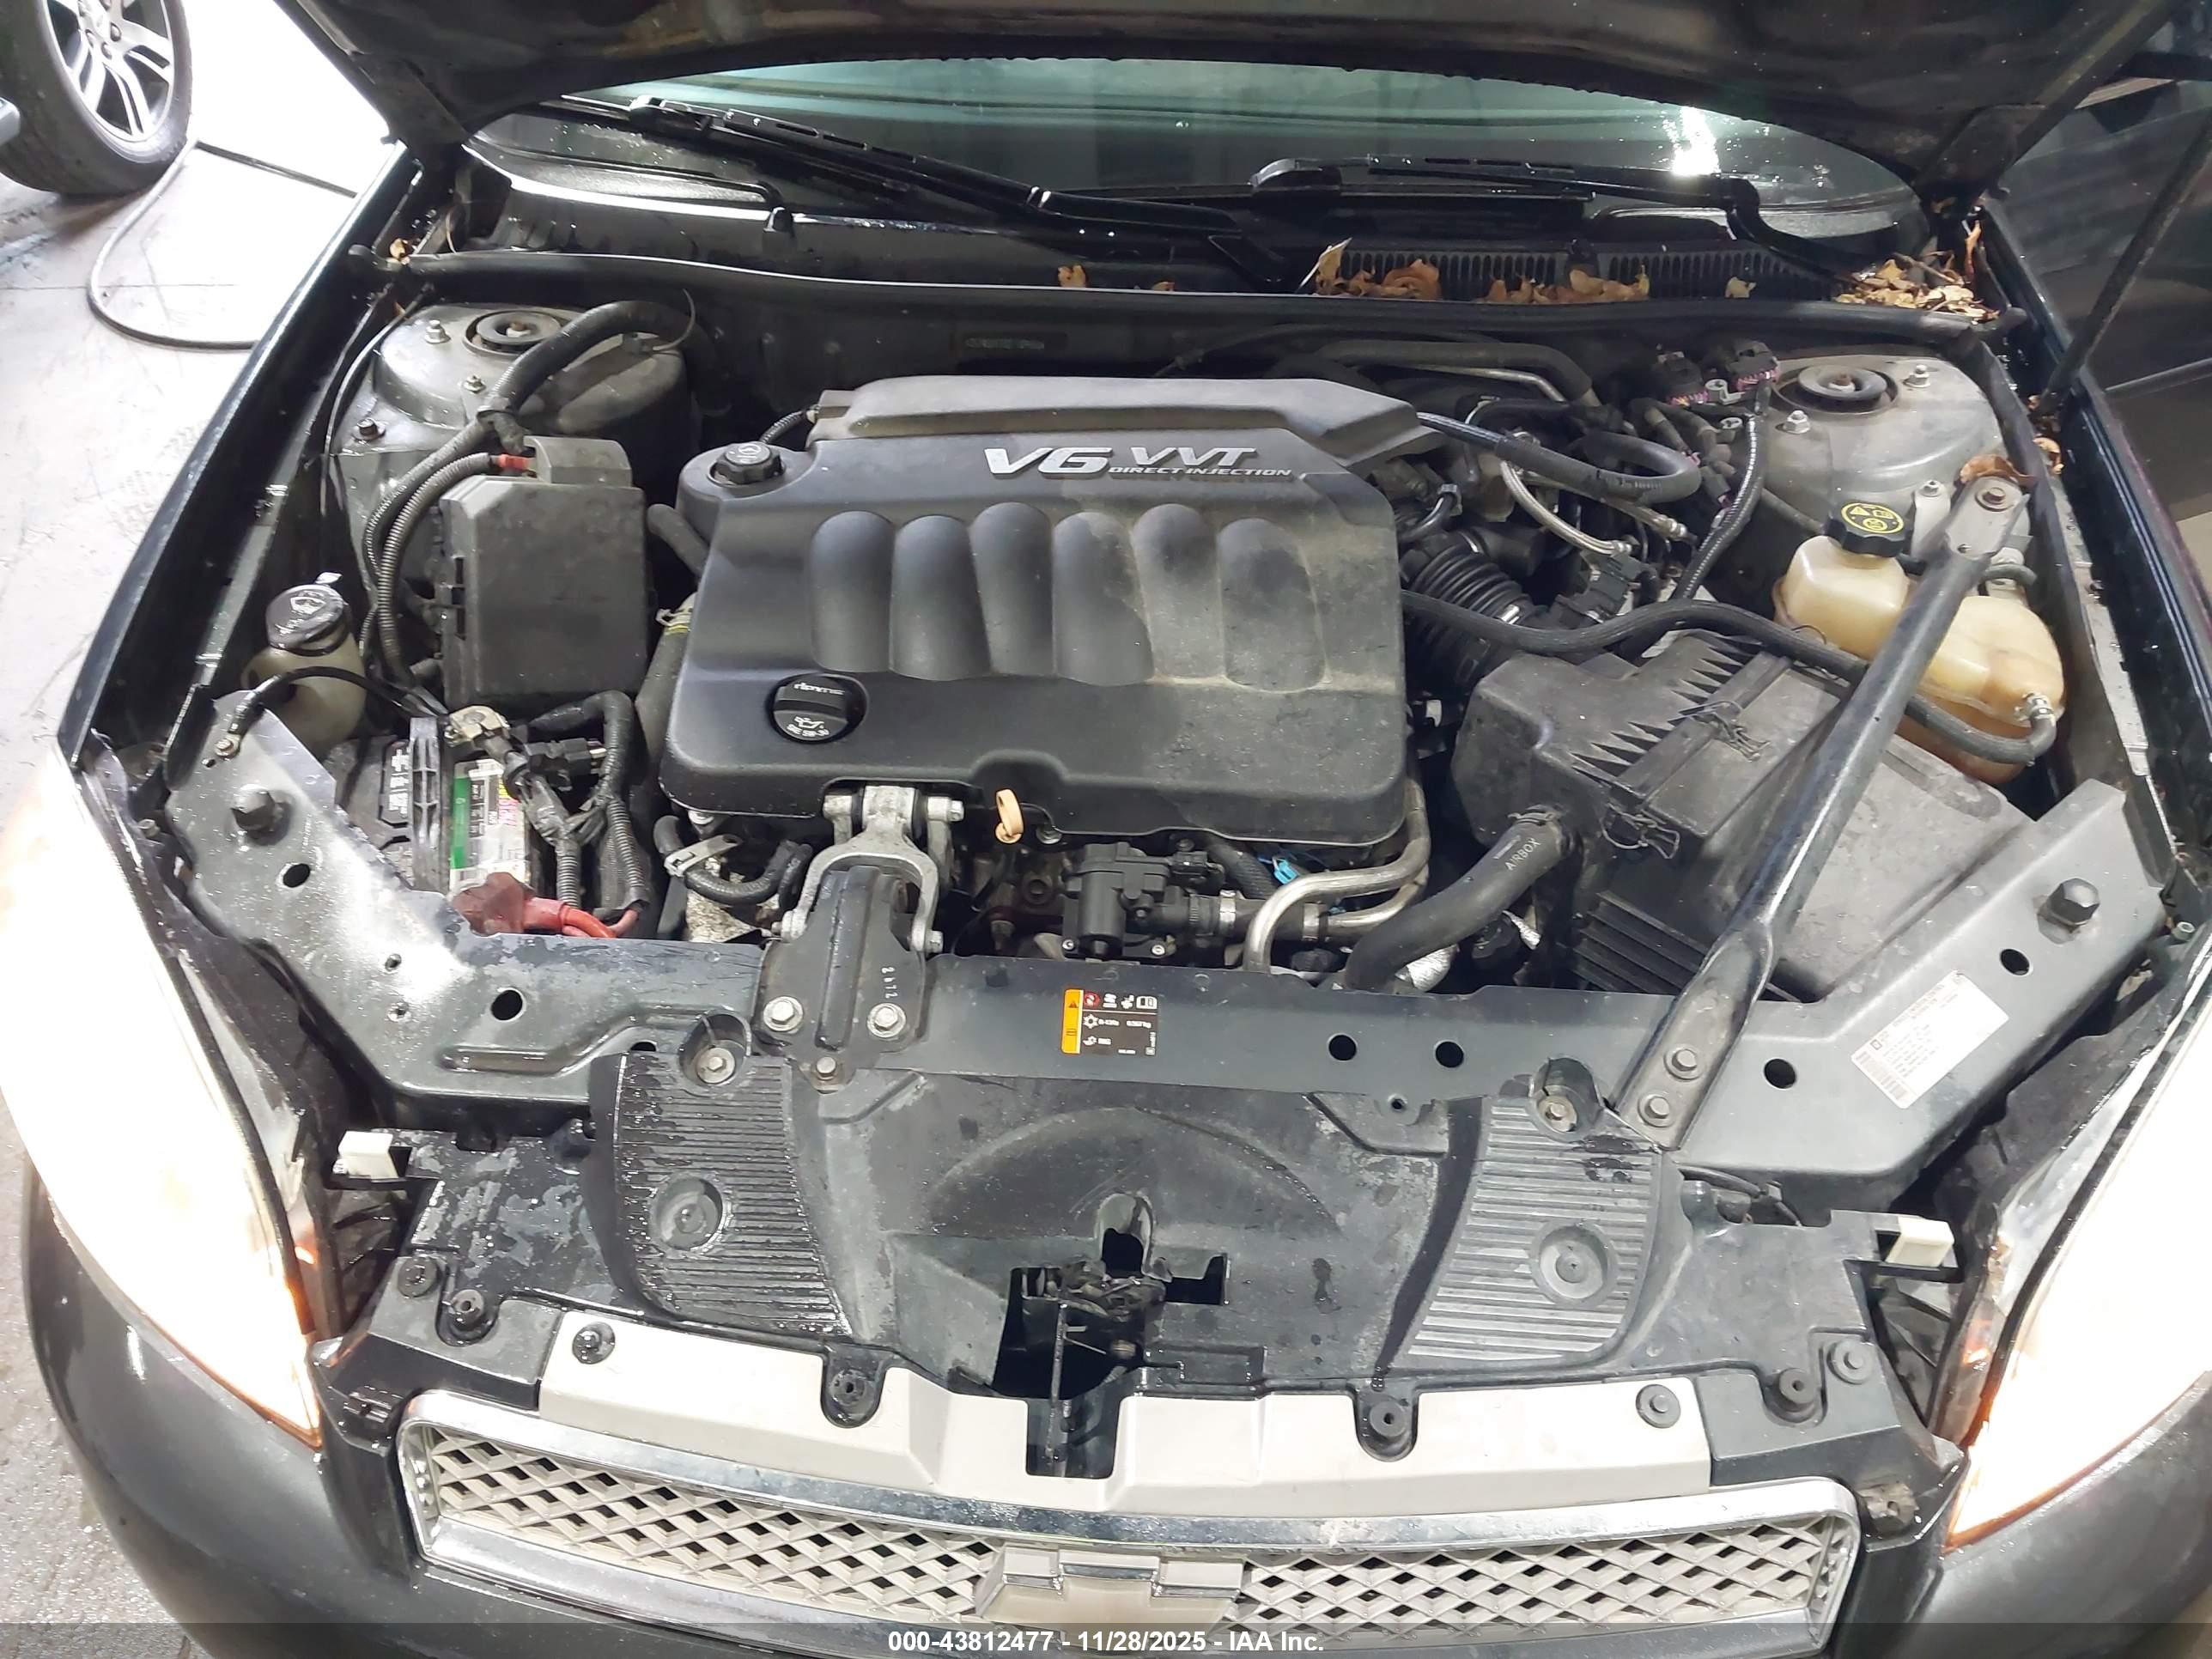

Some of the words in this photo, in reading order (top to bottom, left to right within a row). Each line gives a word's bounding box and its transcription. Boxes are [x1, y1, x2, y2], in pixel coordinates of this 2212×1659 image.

[984, 447, 1113, 474] V6
[1130, 447, 1257, 466] VVT
[1184, 467, 1292, 476] INJECTION
[1504, 837, 1541, 871] AIRBOX
